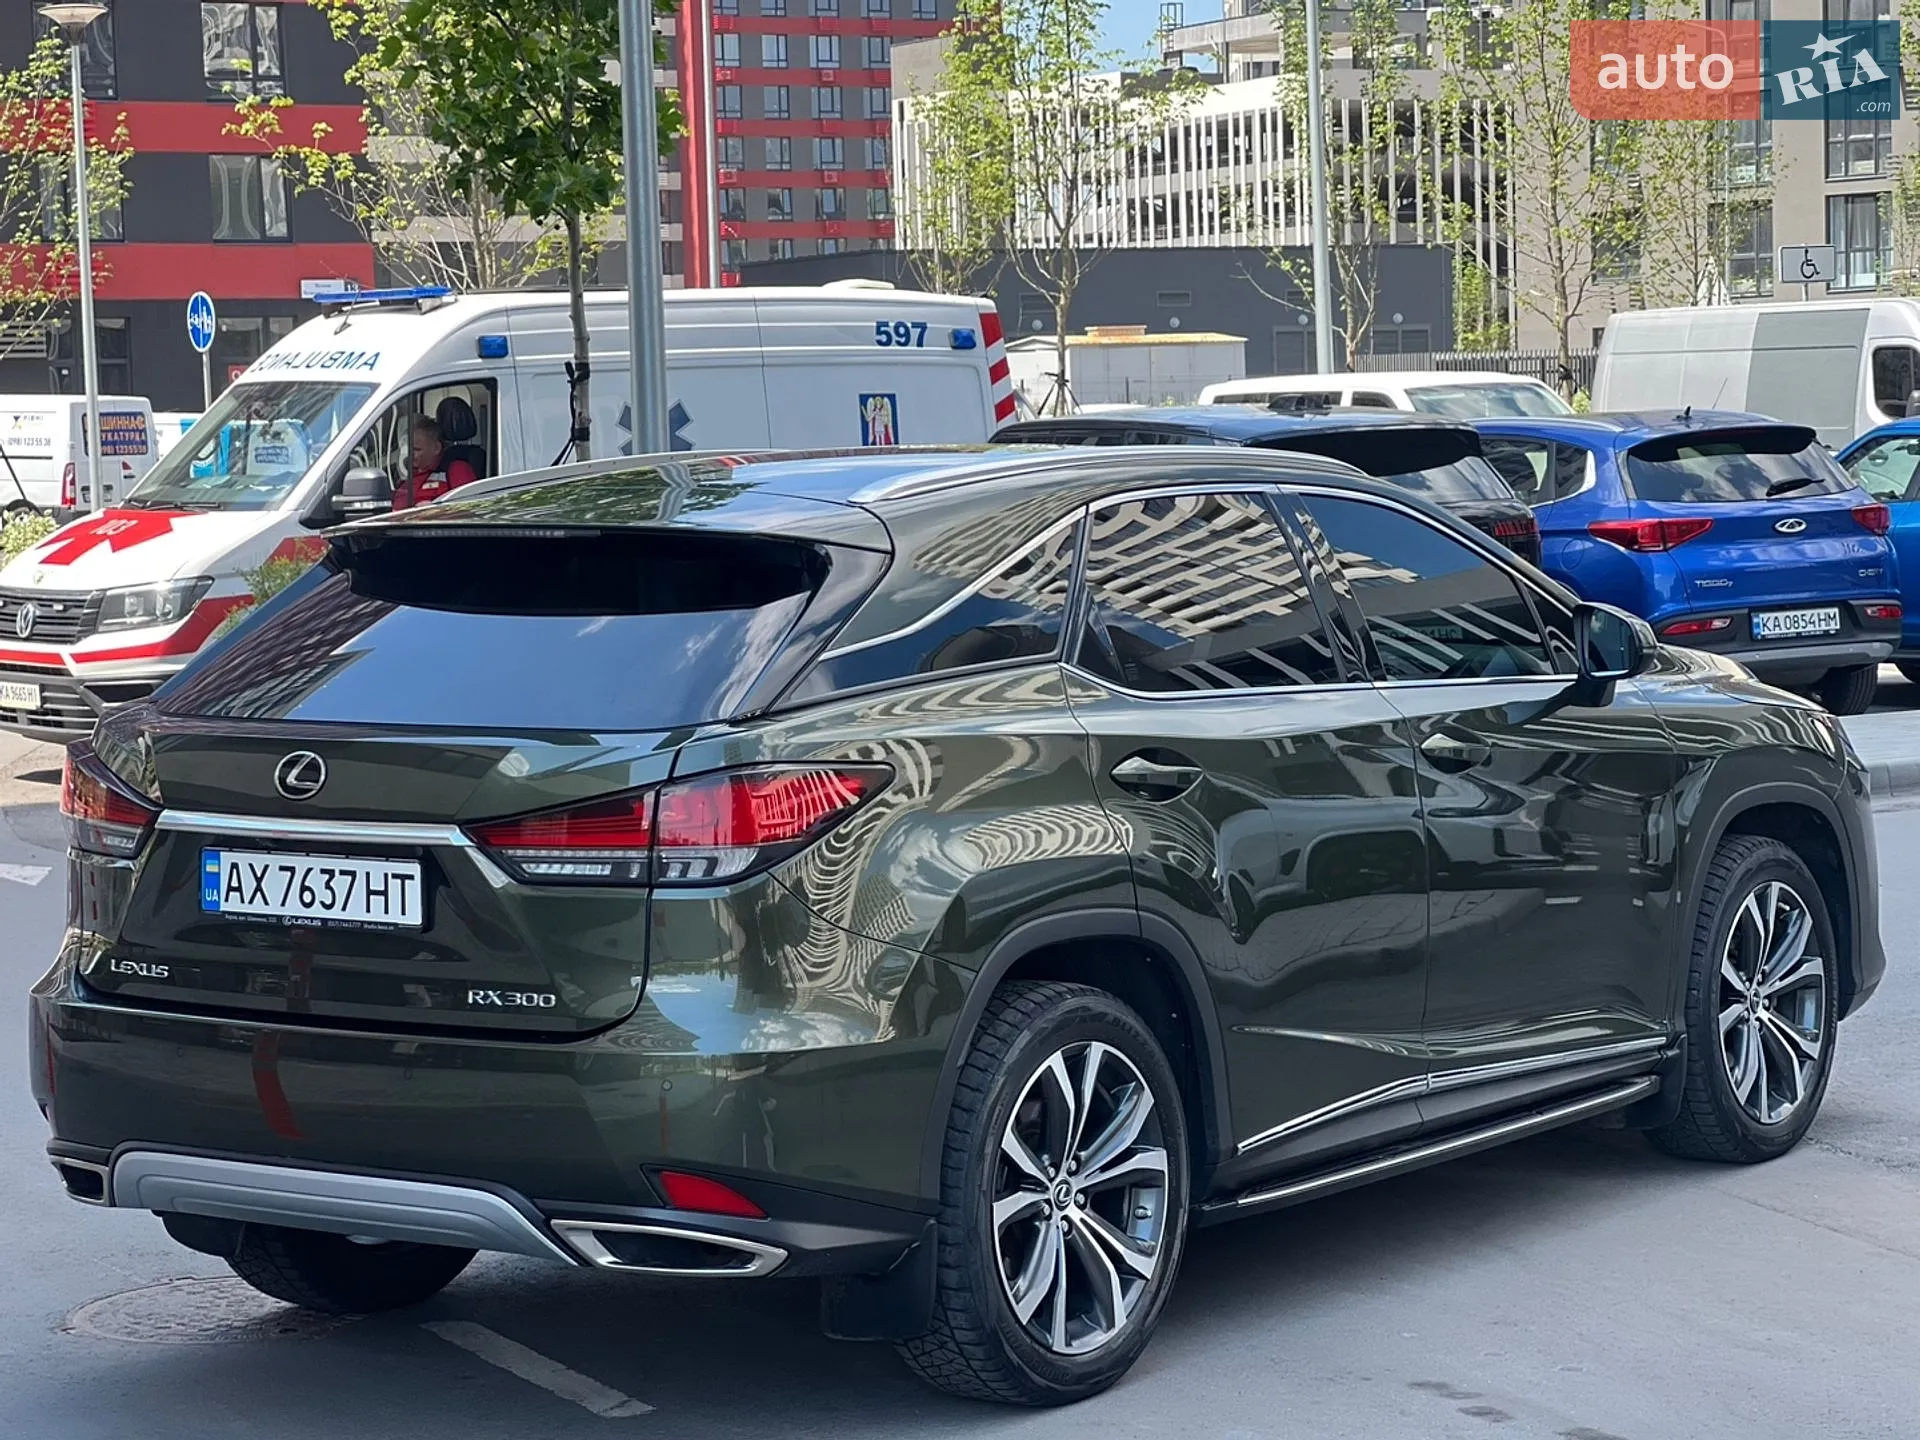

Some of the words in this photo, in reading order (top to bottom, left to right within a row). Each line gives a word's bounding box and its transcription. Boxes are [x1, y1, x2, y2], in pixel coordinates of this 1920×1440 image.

[875, 321, 928, 348] 597
[101, 431, 146, 441] УКАТУРКА
[1784, 614, 1817, 630] 0854
[205, 888, 219, 902] UA
[224, 861, 270, 907] AX
[278, 865, 358, 912] 7637
[365, 871, 415, 916] HT
[110, 958, 169, 978] LEXUS
